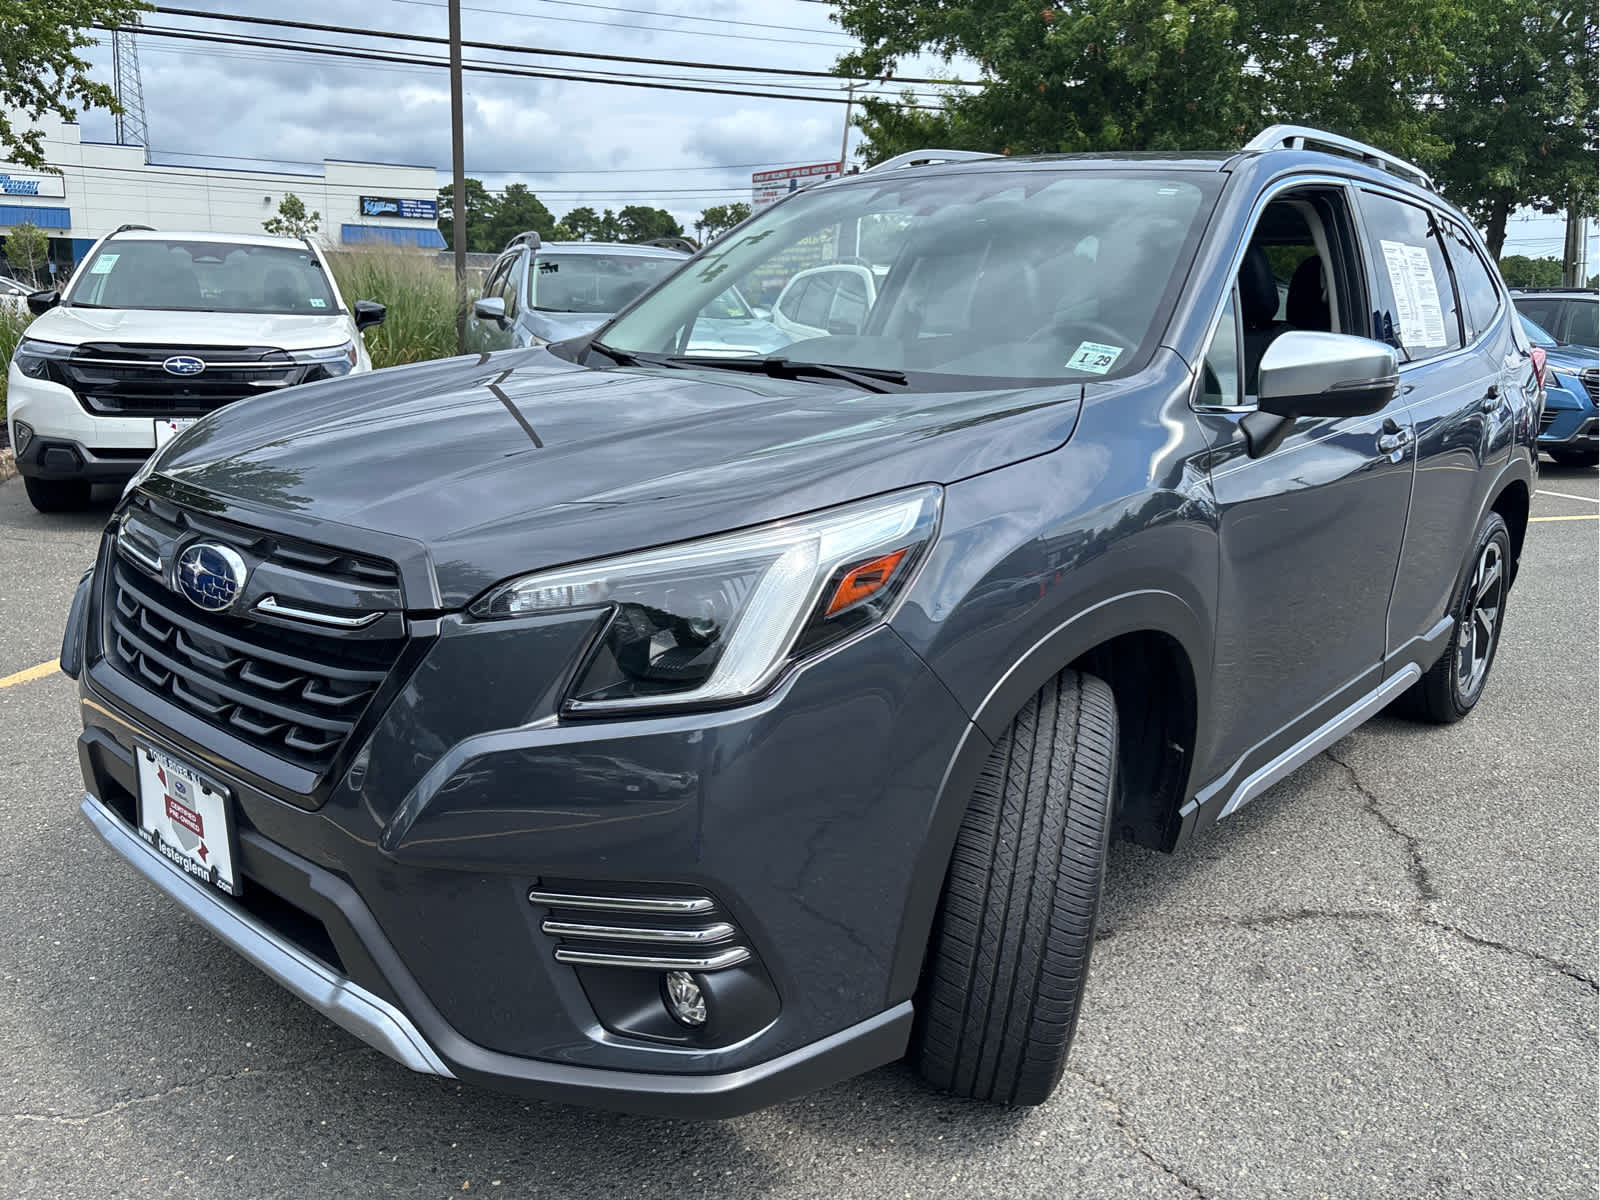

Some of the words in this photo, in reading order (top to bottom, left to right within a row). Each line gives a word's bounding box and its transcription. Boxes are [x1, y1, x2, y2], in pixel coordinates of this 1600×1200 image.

[1093, 355, 1112, 366] 29
[169, 808, 199, 832] PRE-OWNED
[170, 801, 197, 822] CERTIFIED
[159, 839, 210, 882] lesterglenn
